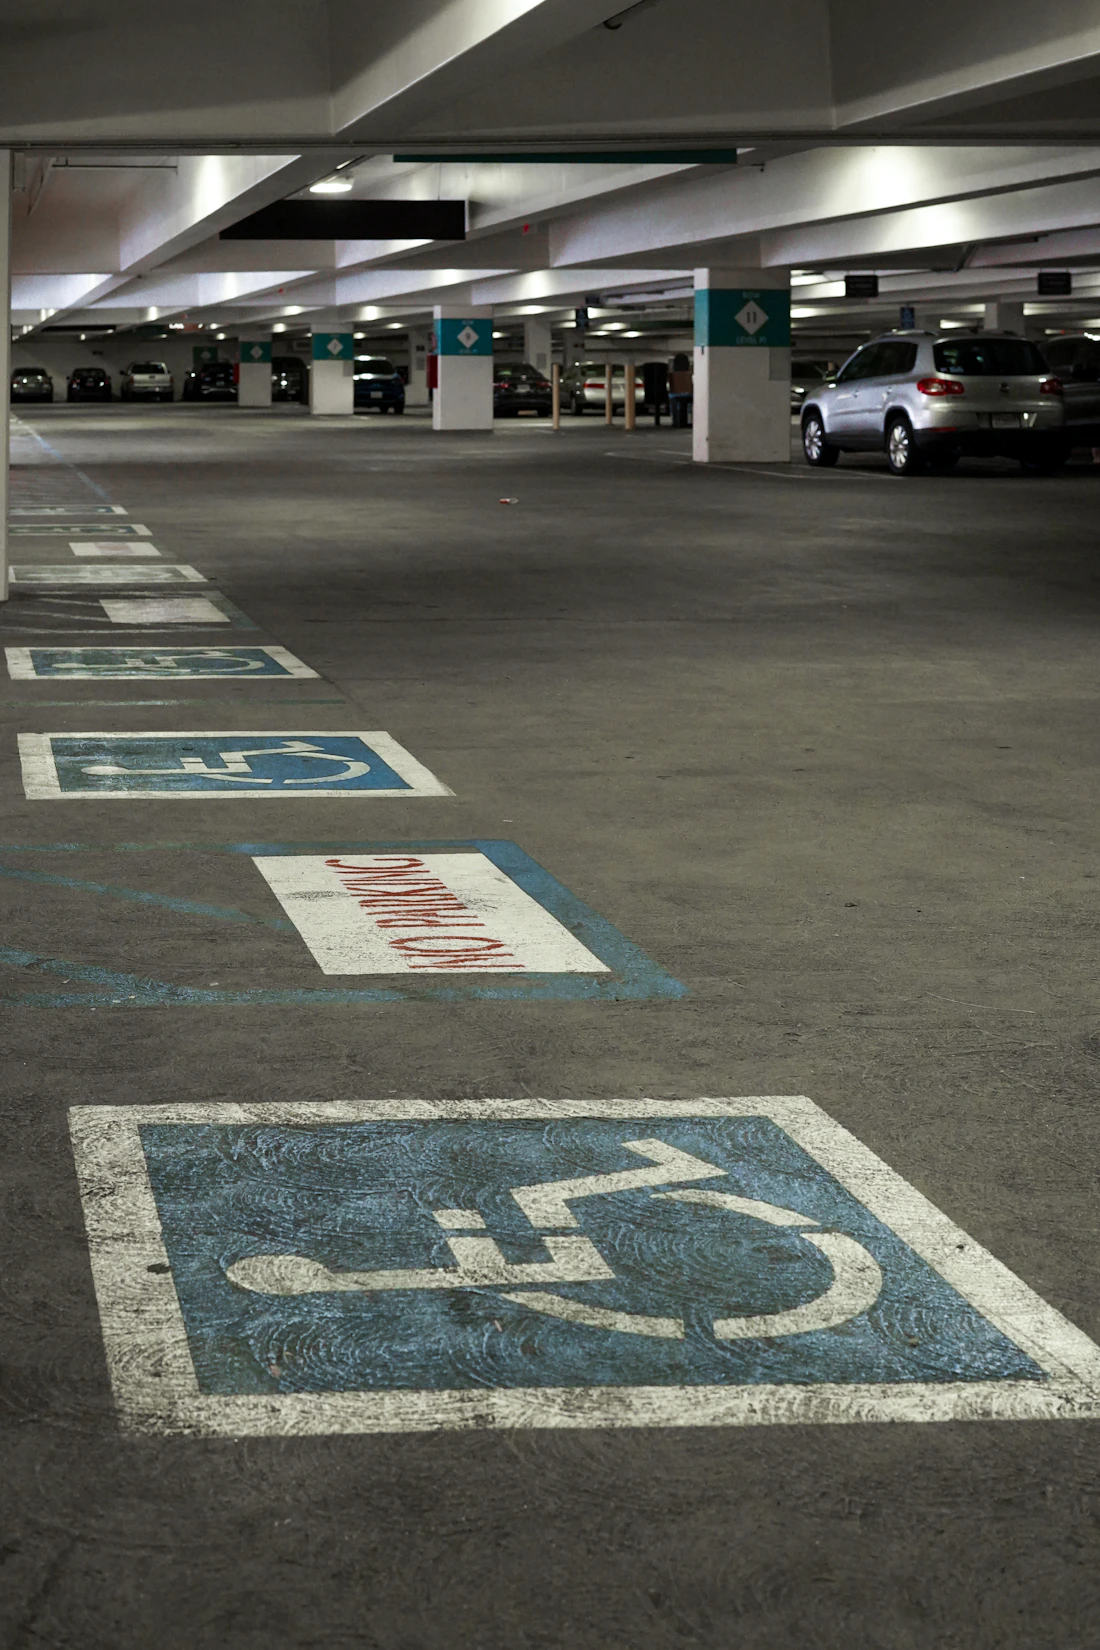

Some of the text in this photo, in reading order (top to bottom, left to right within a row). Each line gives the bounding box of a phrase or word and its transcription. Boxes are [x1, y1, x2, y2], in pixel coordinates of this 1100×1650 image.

[746, 311, 757, 324] 11
[325, 857, 524, 969] NO PARKING
